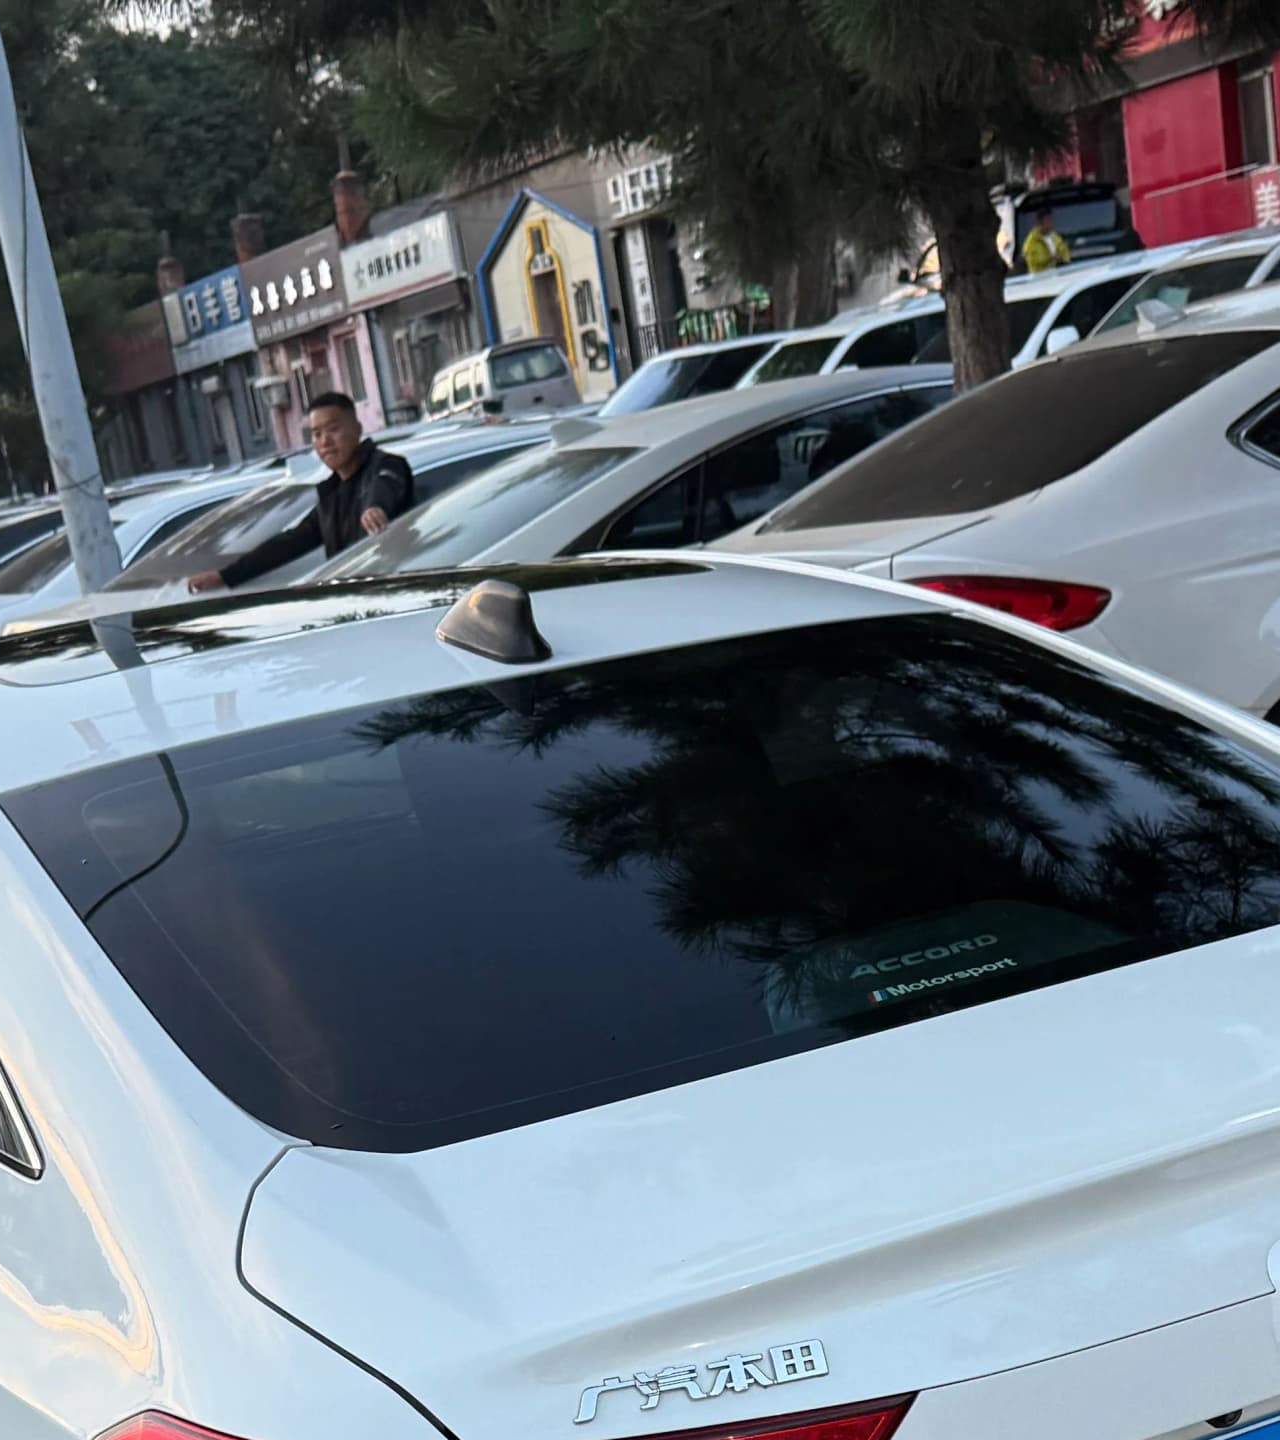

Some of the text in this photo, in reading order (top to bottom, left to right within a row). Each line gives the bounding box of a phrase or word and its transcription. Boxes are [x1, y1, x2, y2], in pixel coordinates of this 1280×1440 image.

[849, 933, 999, 980] ACCORD
[886, 957, 1019, 998] Motorsport
[573, 1338, 830, 1425] 广汽本田
